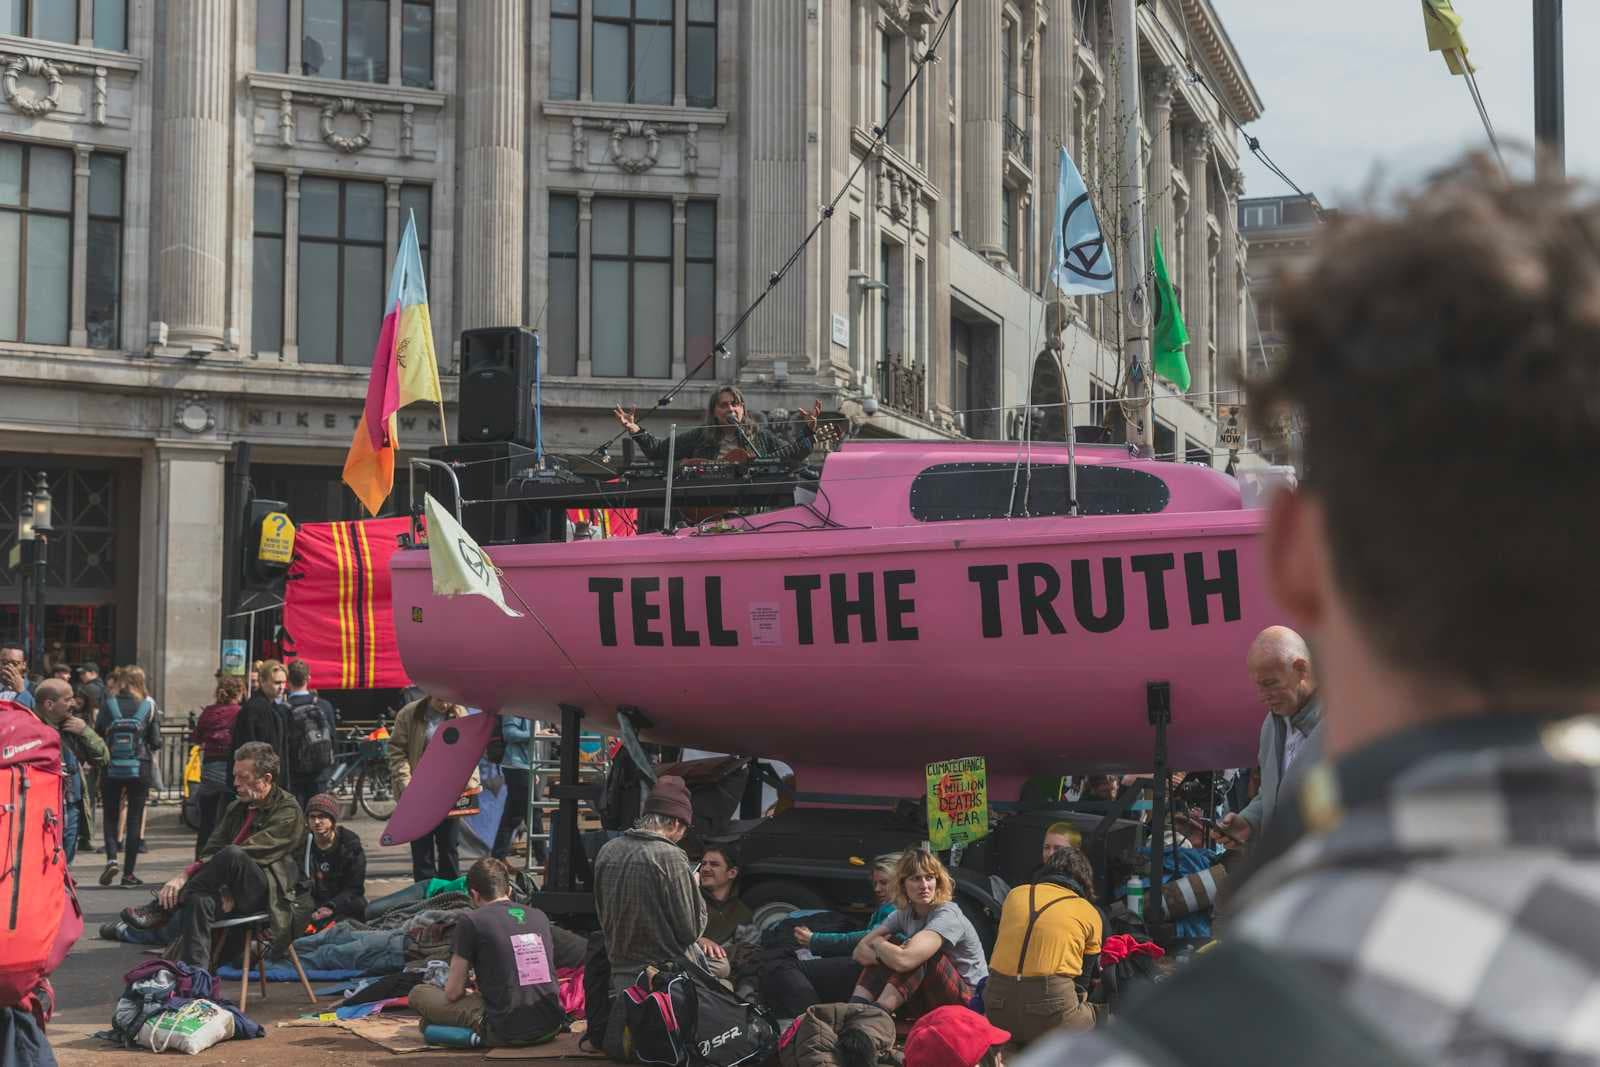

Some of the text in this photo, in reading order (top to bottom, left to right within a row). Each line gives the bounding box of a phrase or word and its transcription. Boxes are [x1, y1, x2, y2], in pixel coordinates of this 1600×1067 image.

[248, 411, 440, 430] NIKETWN
[1220, 435, 1240, 443] NOW
[588, 548, 1241, 646] TELL THE TRUTH
[944, 779, 984, 793] MILLION
[939, 792, 983, 812] DEATHS
[936, 810, 980, 830] A YEAR
[711, 1026, 743, 1048] SFR
